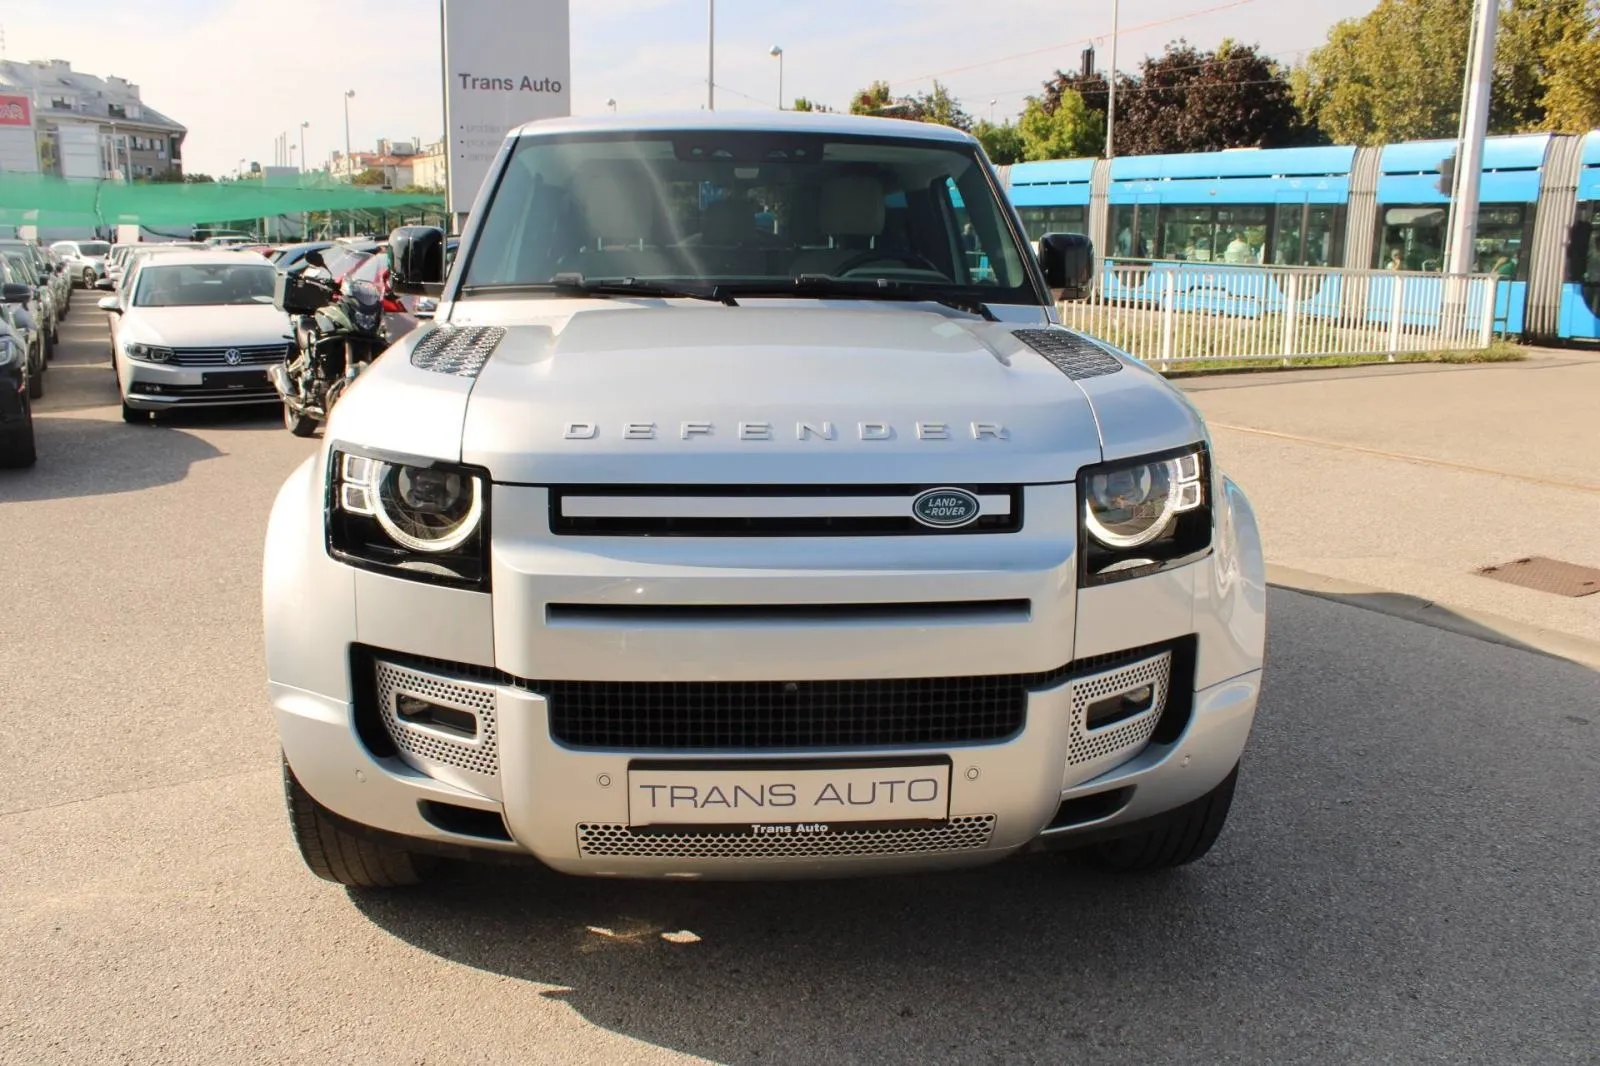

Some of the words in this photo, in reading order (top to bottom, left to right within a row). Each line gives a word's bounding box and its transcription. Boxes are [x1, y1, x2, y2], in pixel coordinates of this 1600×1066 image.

[458, 73, 513, 91] Trans
[519, 76, 562, 93] Auto
[562, 421, 1009, 440] DEFENDER
[639, 783, 797, 808] TRANS
[814, 778, 939, 806] AUTO
[752, 824, 792, 834] Trans
[796, 823, 829, 834] Auto
